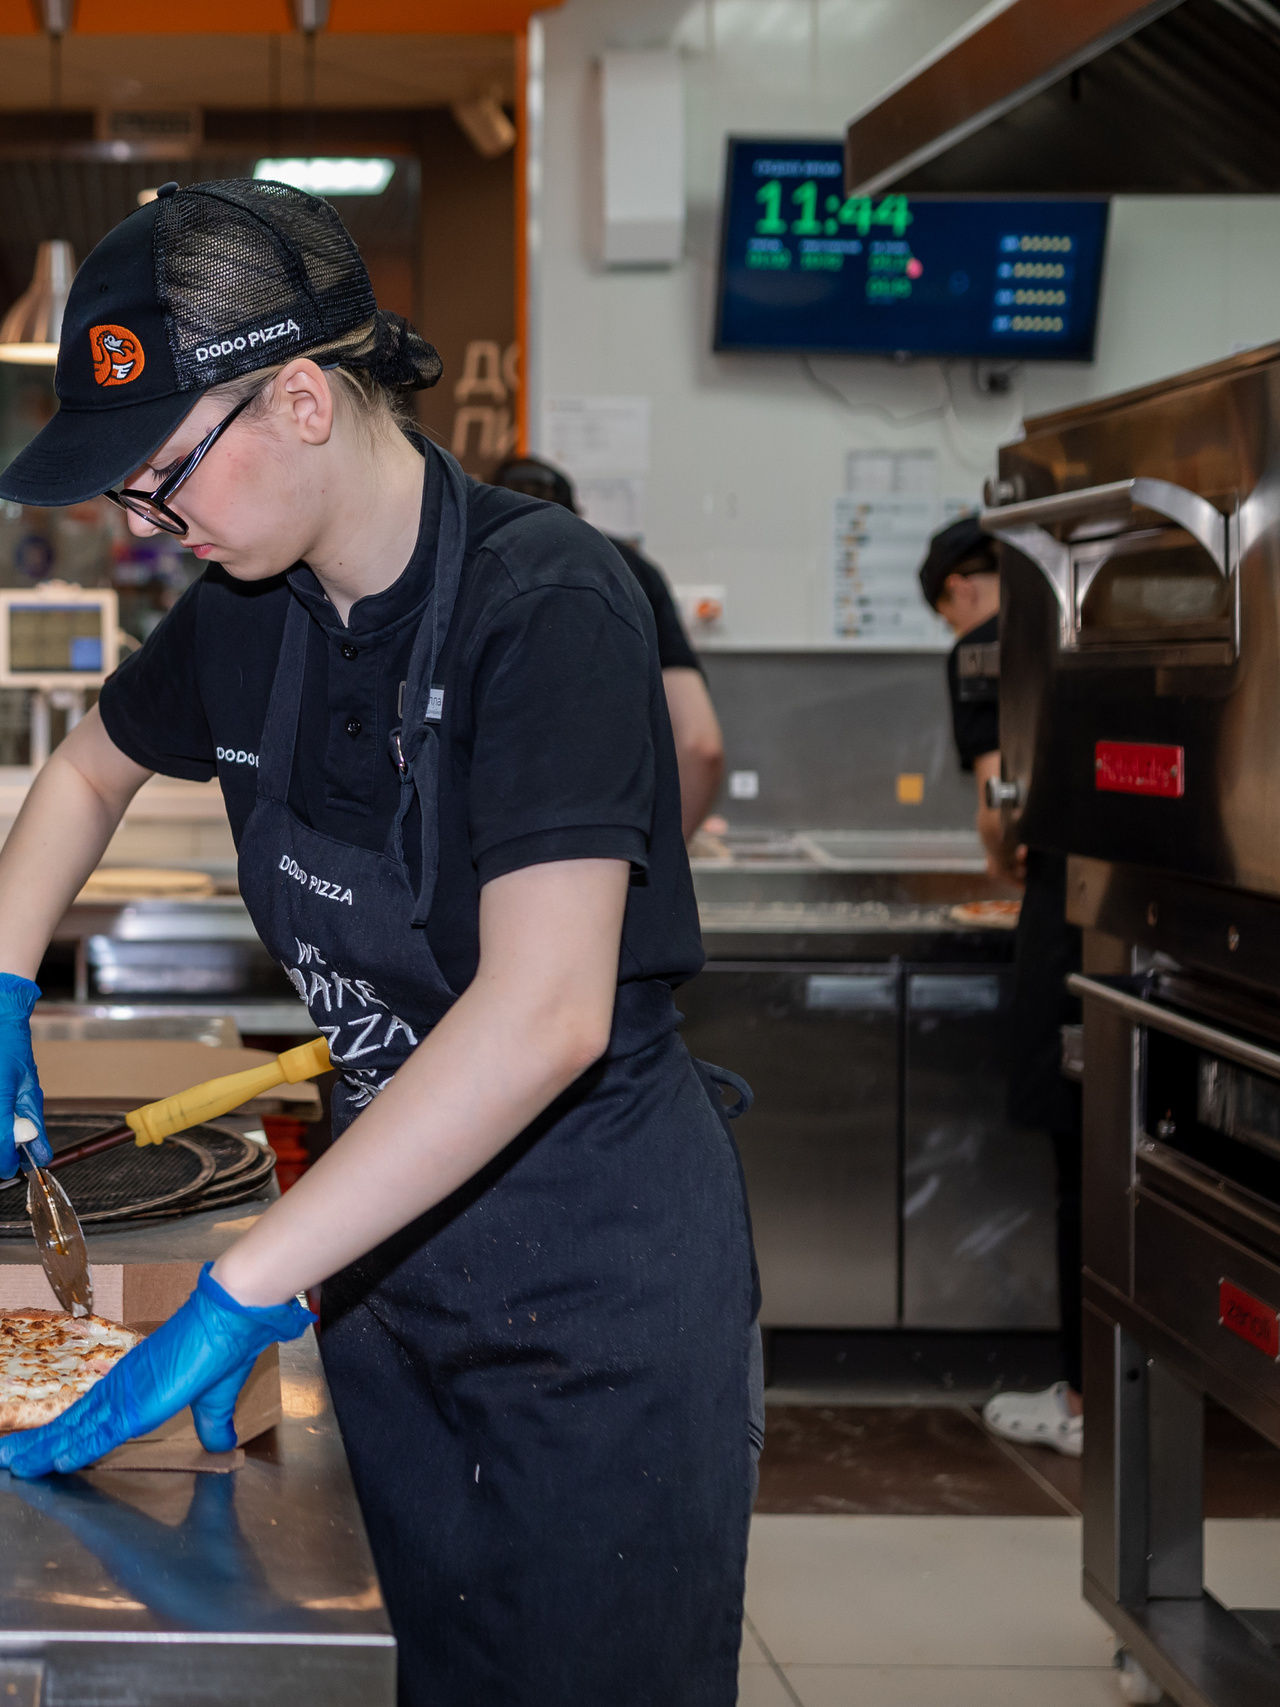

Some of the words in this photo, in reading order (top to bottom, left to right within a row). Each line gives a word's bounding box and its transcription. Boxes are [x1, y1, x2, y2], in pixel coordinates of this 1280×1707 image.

[755, 179, 914, 237] 11:44
[196, 336, 246, 361] DODO
[248, 319, 300, 347] PIZZA
[279, 855, 308, 884] DODO
[309, 875, 353, 905] PIZZA
[295, 937, 326, 964] WE
